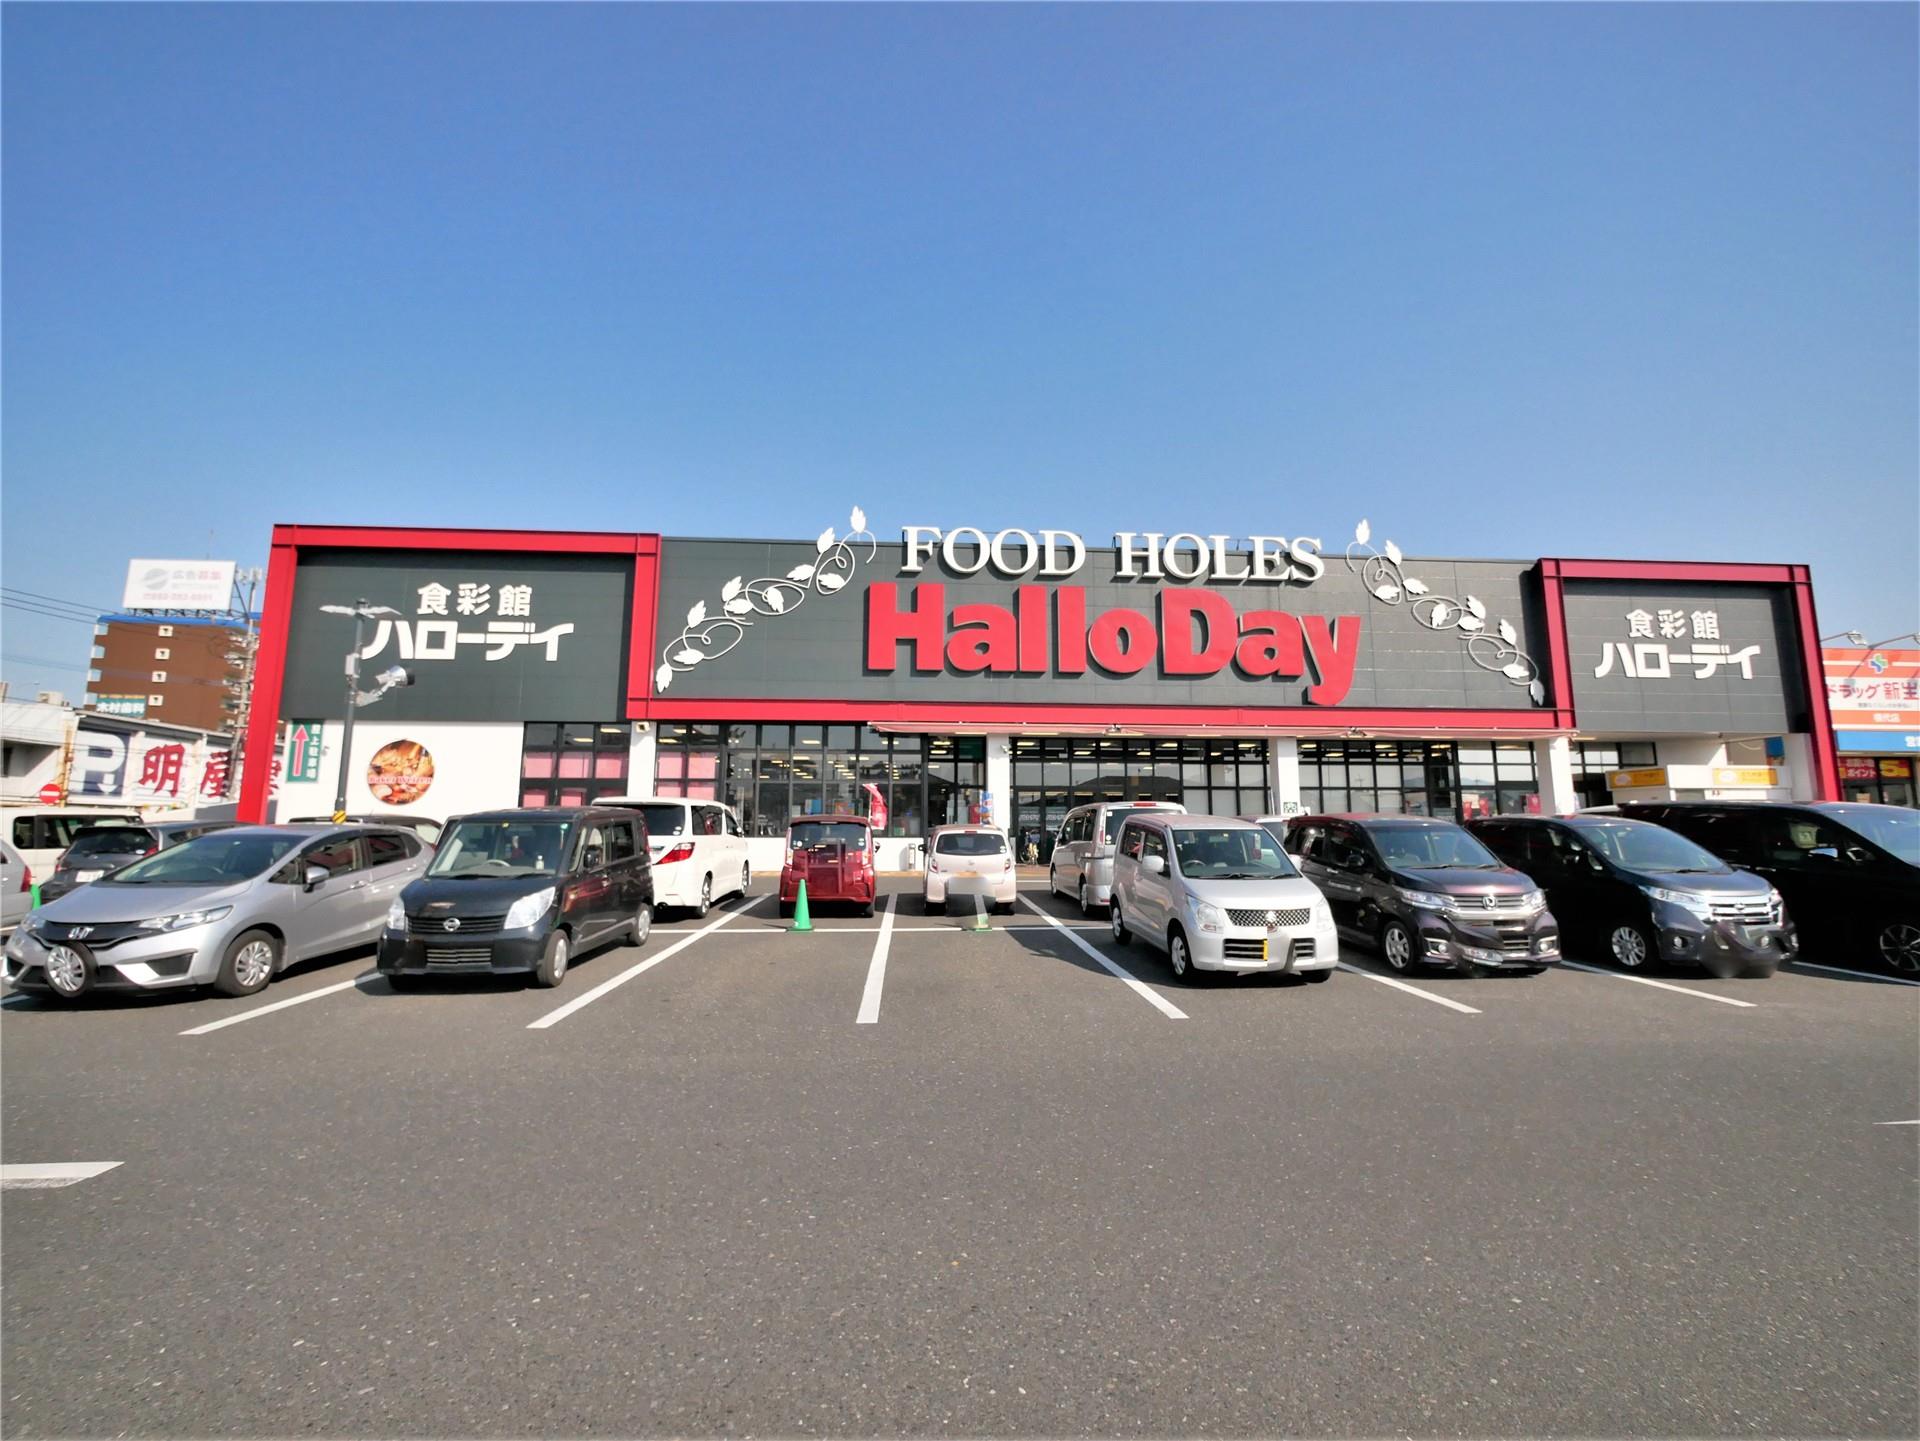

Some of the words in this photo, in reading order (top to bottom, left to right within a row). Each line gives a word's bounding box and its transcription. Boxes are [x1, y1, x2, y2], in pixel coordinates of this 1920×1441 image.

[900, 525, 1087, 576] FOOD
[1114, 531, 1326, 582] HOLES
[416, 582, 533, 616] 食彩館
[867, 582, 1362, 706] HalloDay
[1625, 608, 1720, 640] 食彩館
